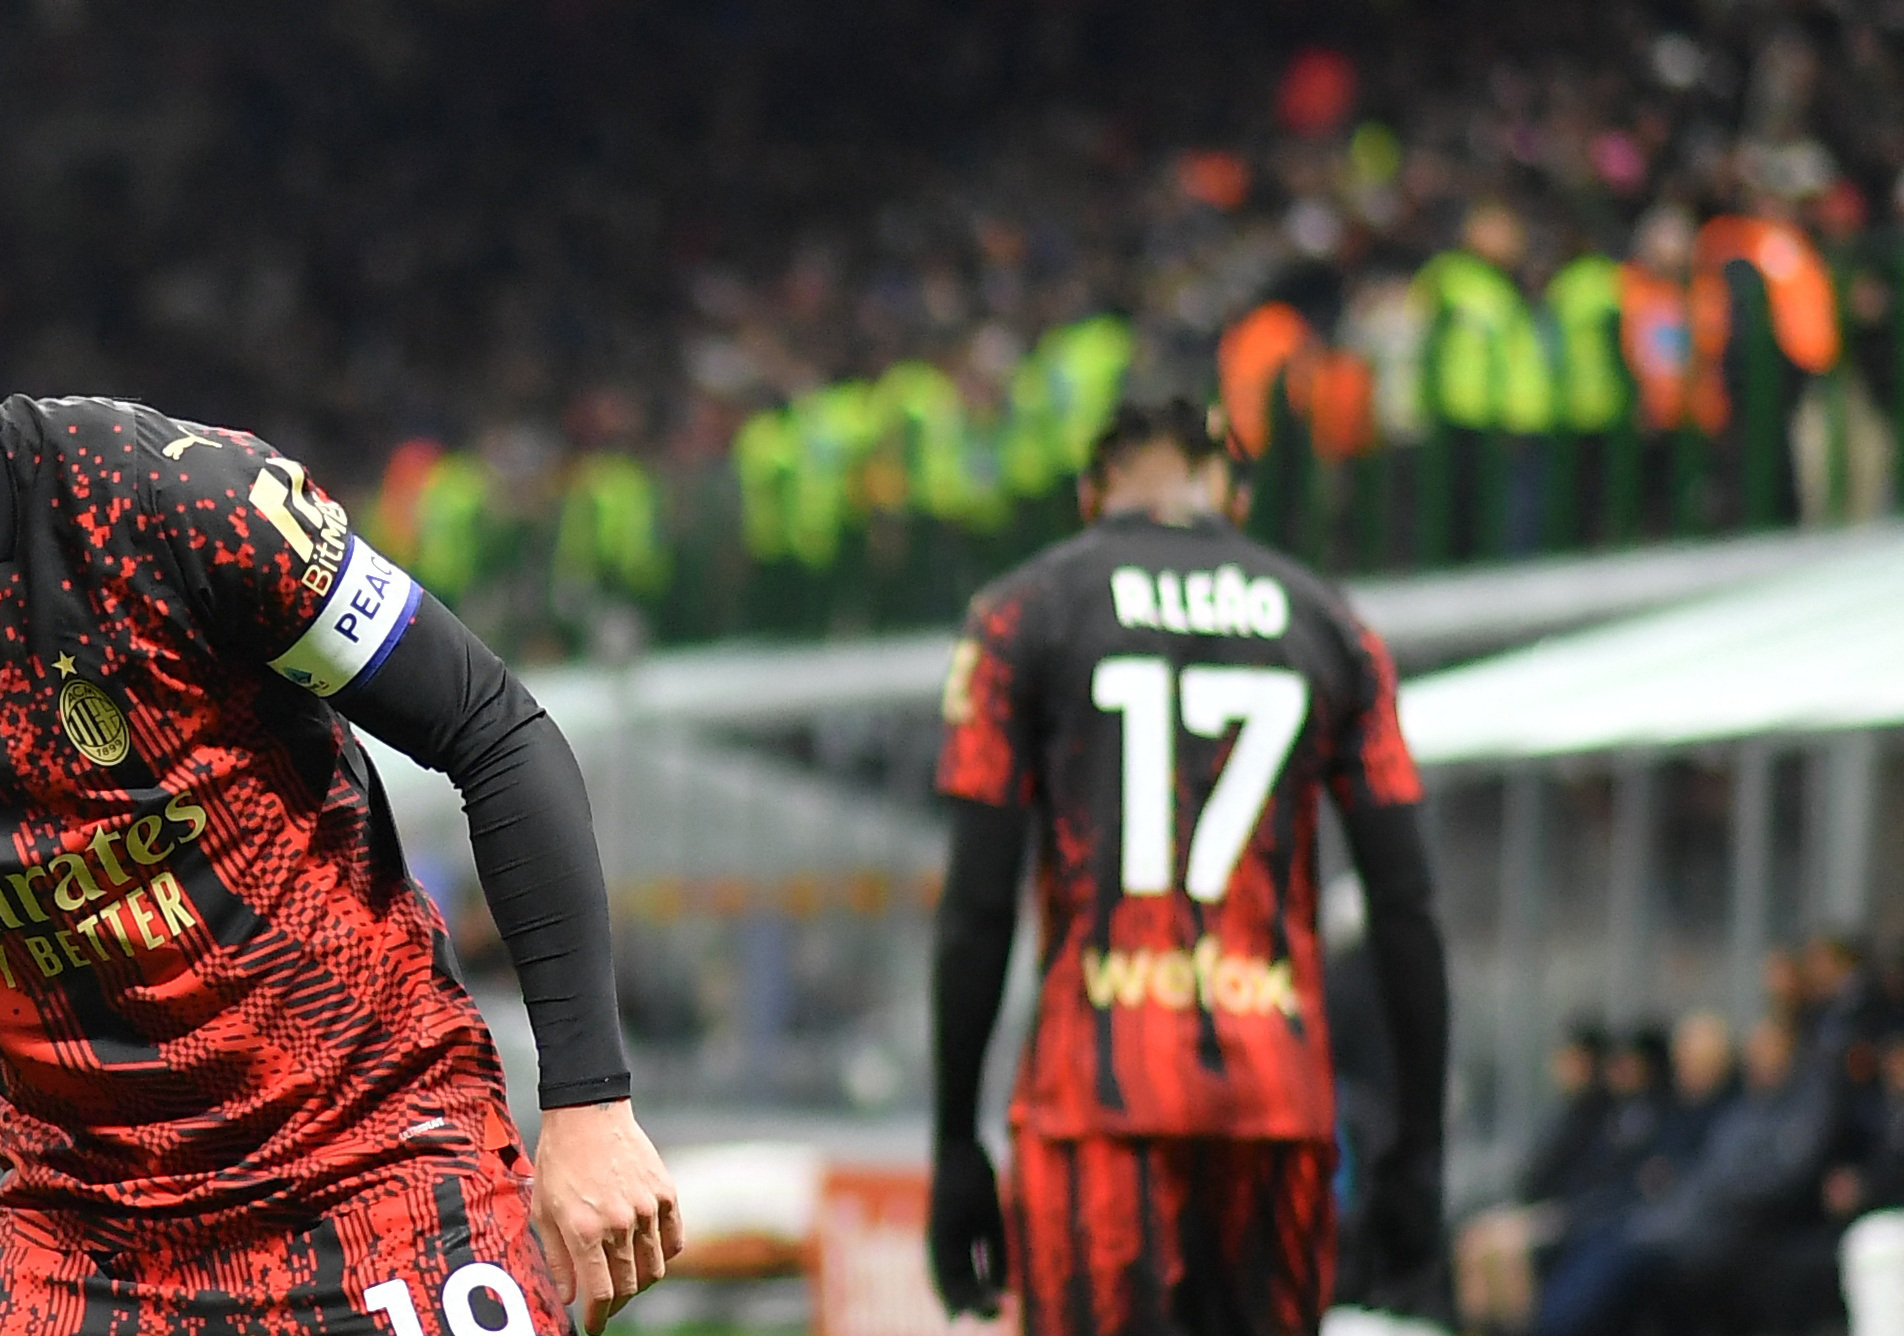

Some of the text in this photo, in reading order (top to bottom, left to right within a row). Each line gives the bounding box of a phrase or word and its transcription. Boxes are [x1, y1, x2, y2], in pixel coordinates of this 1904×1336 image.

[96, 739, 123, 757] 1899
[1092, 655, 1310, 904] 17
[24, 871, 197, 978] BETTER
